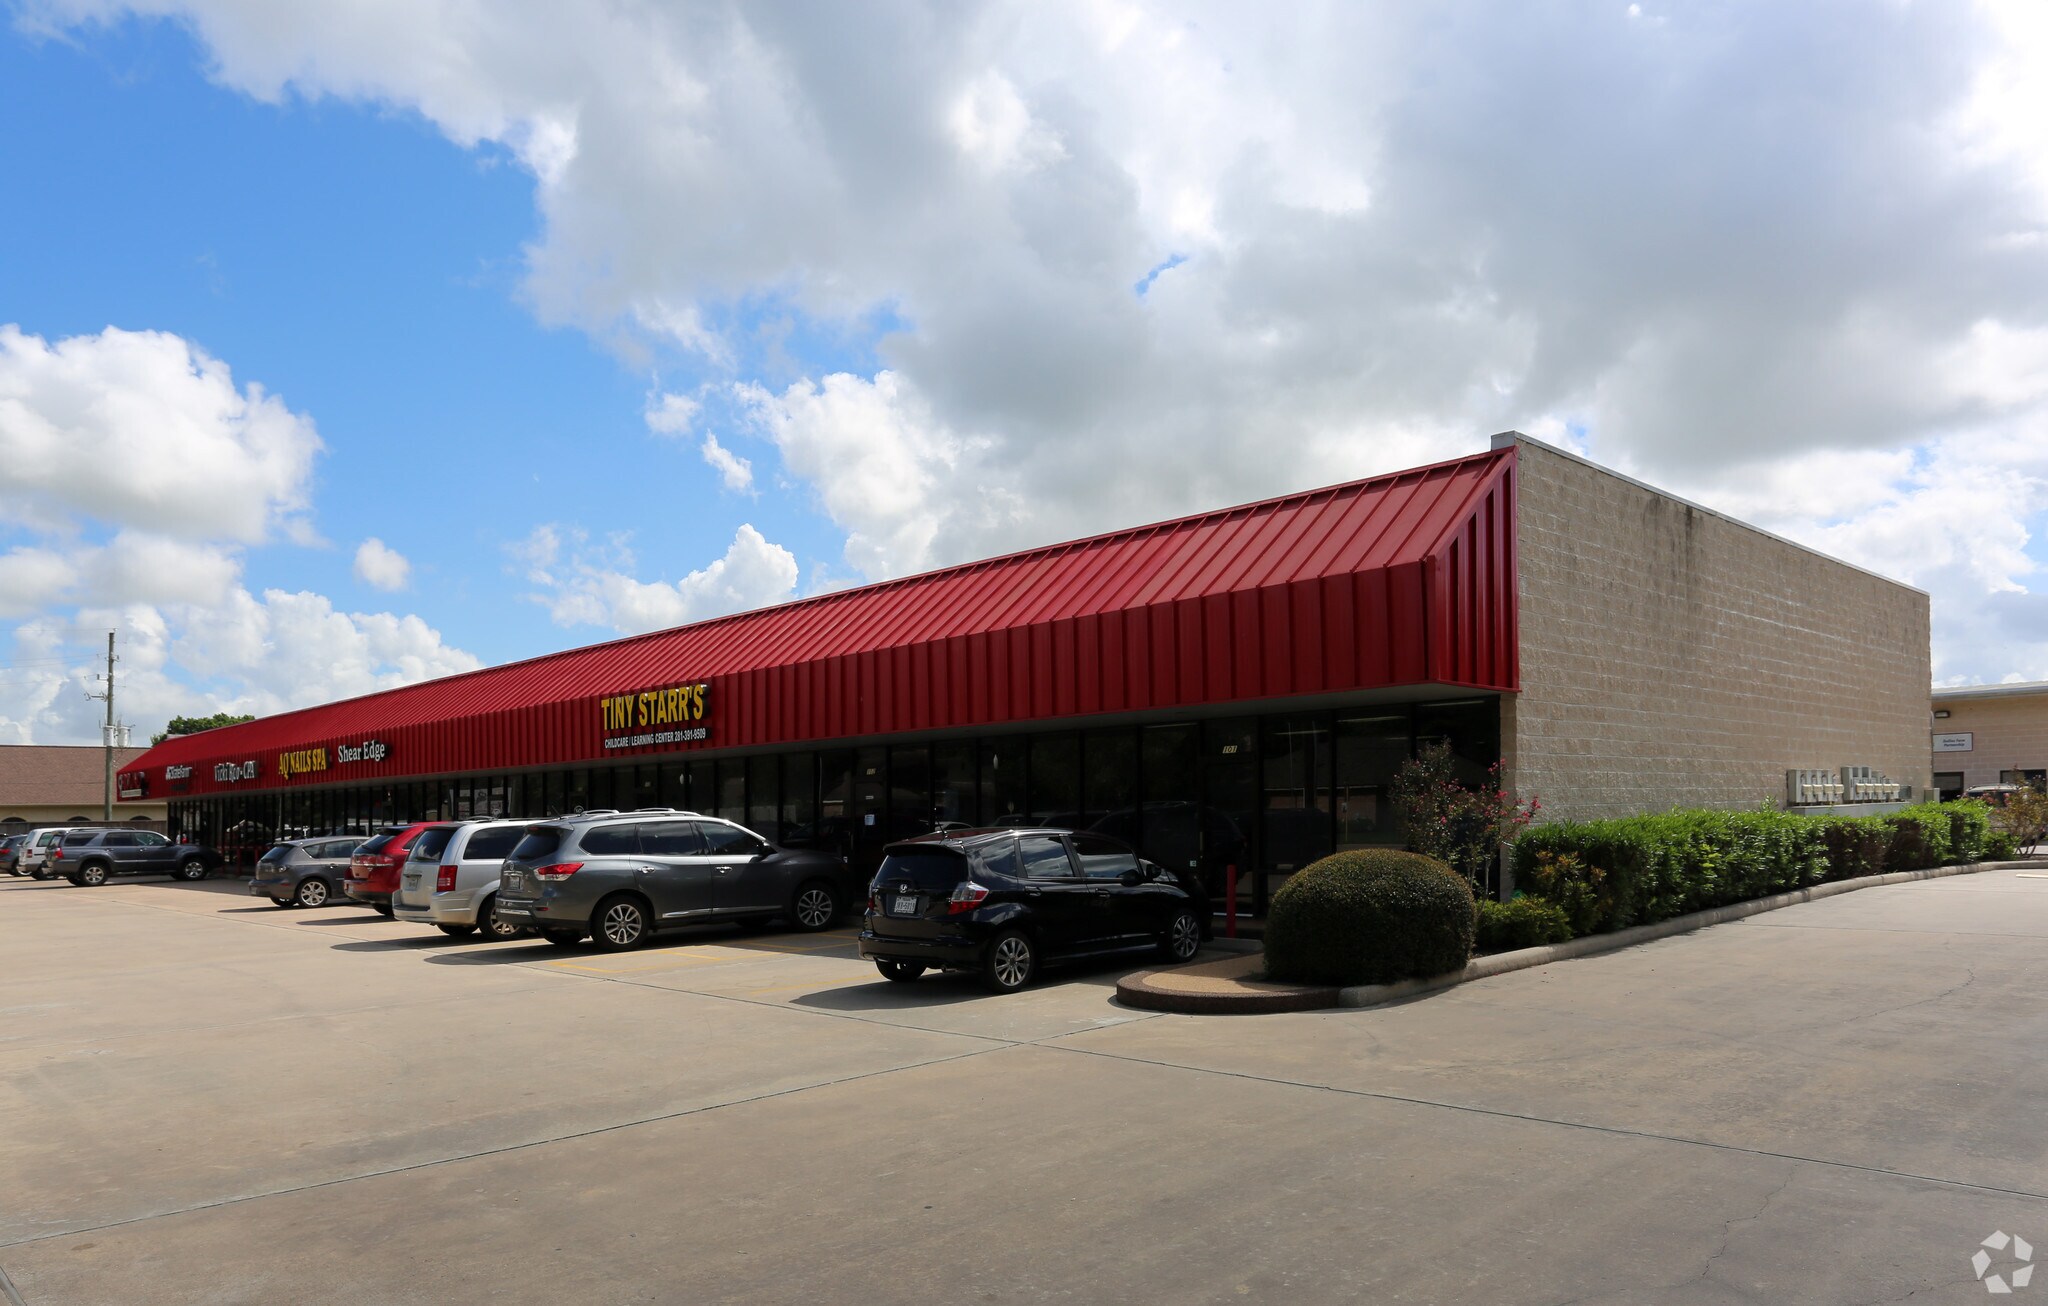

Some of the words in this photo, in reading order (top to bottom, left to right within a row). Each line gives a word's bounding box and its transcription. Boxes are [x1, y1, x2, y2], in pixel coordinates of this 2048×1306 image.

[601, 695, 635, 730] TINY
[639, 684, 704, 726] STARR'S
[338, 745, 362, 763] Shear
[363, 740, 385, 761] Edge
[605, 737, 628, 748] CHILDCARE
[632, 733, 654, 746] LEARNING
[655, 731, 674, 743] CENTER
[279, 752, 289, 779] AQ
[290, 749, 311, 773] NAILS
[312, 747, 326, 770] SPA
